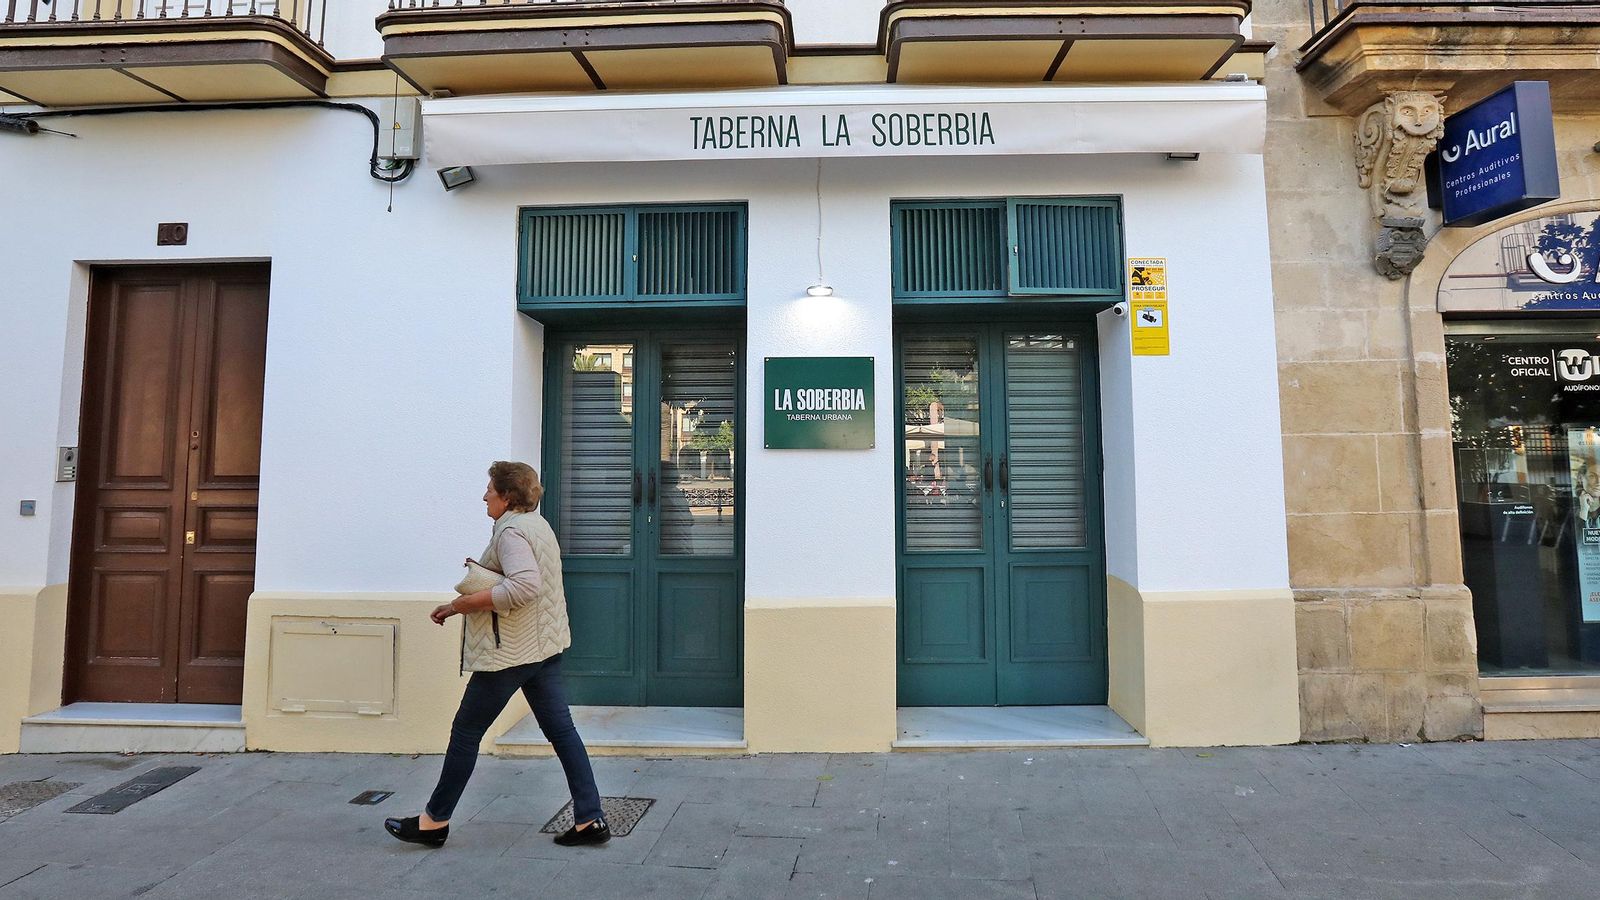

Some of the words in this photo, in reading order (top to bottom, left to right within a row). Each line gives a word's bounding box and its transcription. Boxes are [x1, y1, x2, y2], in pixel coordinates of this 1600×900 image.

[689, 115, 801, 150] TABERNA
[822, 114, 851, 147] LA
[871, 112, 996, 148] SOBERBIA
[1464, 111, 1517, 156] Aural
[1446, 171, 1476, 189] Centros
[1478, 152, 1521, 176] Auditivos
[1455, 170, 1511, 198] Profesionales
[160, 224, 185, 242] 10
[1507, 356, 1550, 365] CENTRO
[1510, 367, 1551, 377] OFICIAL
[1563, 383, 1600, 392] AUDÍFONO
[774, 388, 793, 411] LA
[796, 388, 866, 411] SOBERBIA
[786, 413, 821, 421] TABERNA
[821, 413, 853, 421] URBANA
